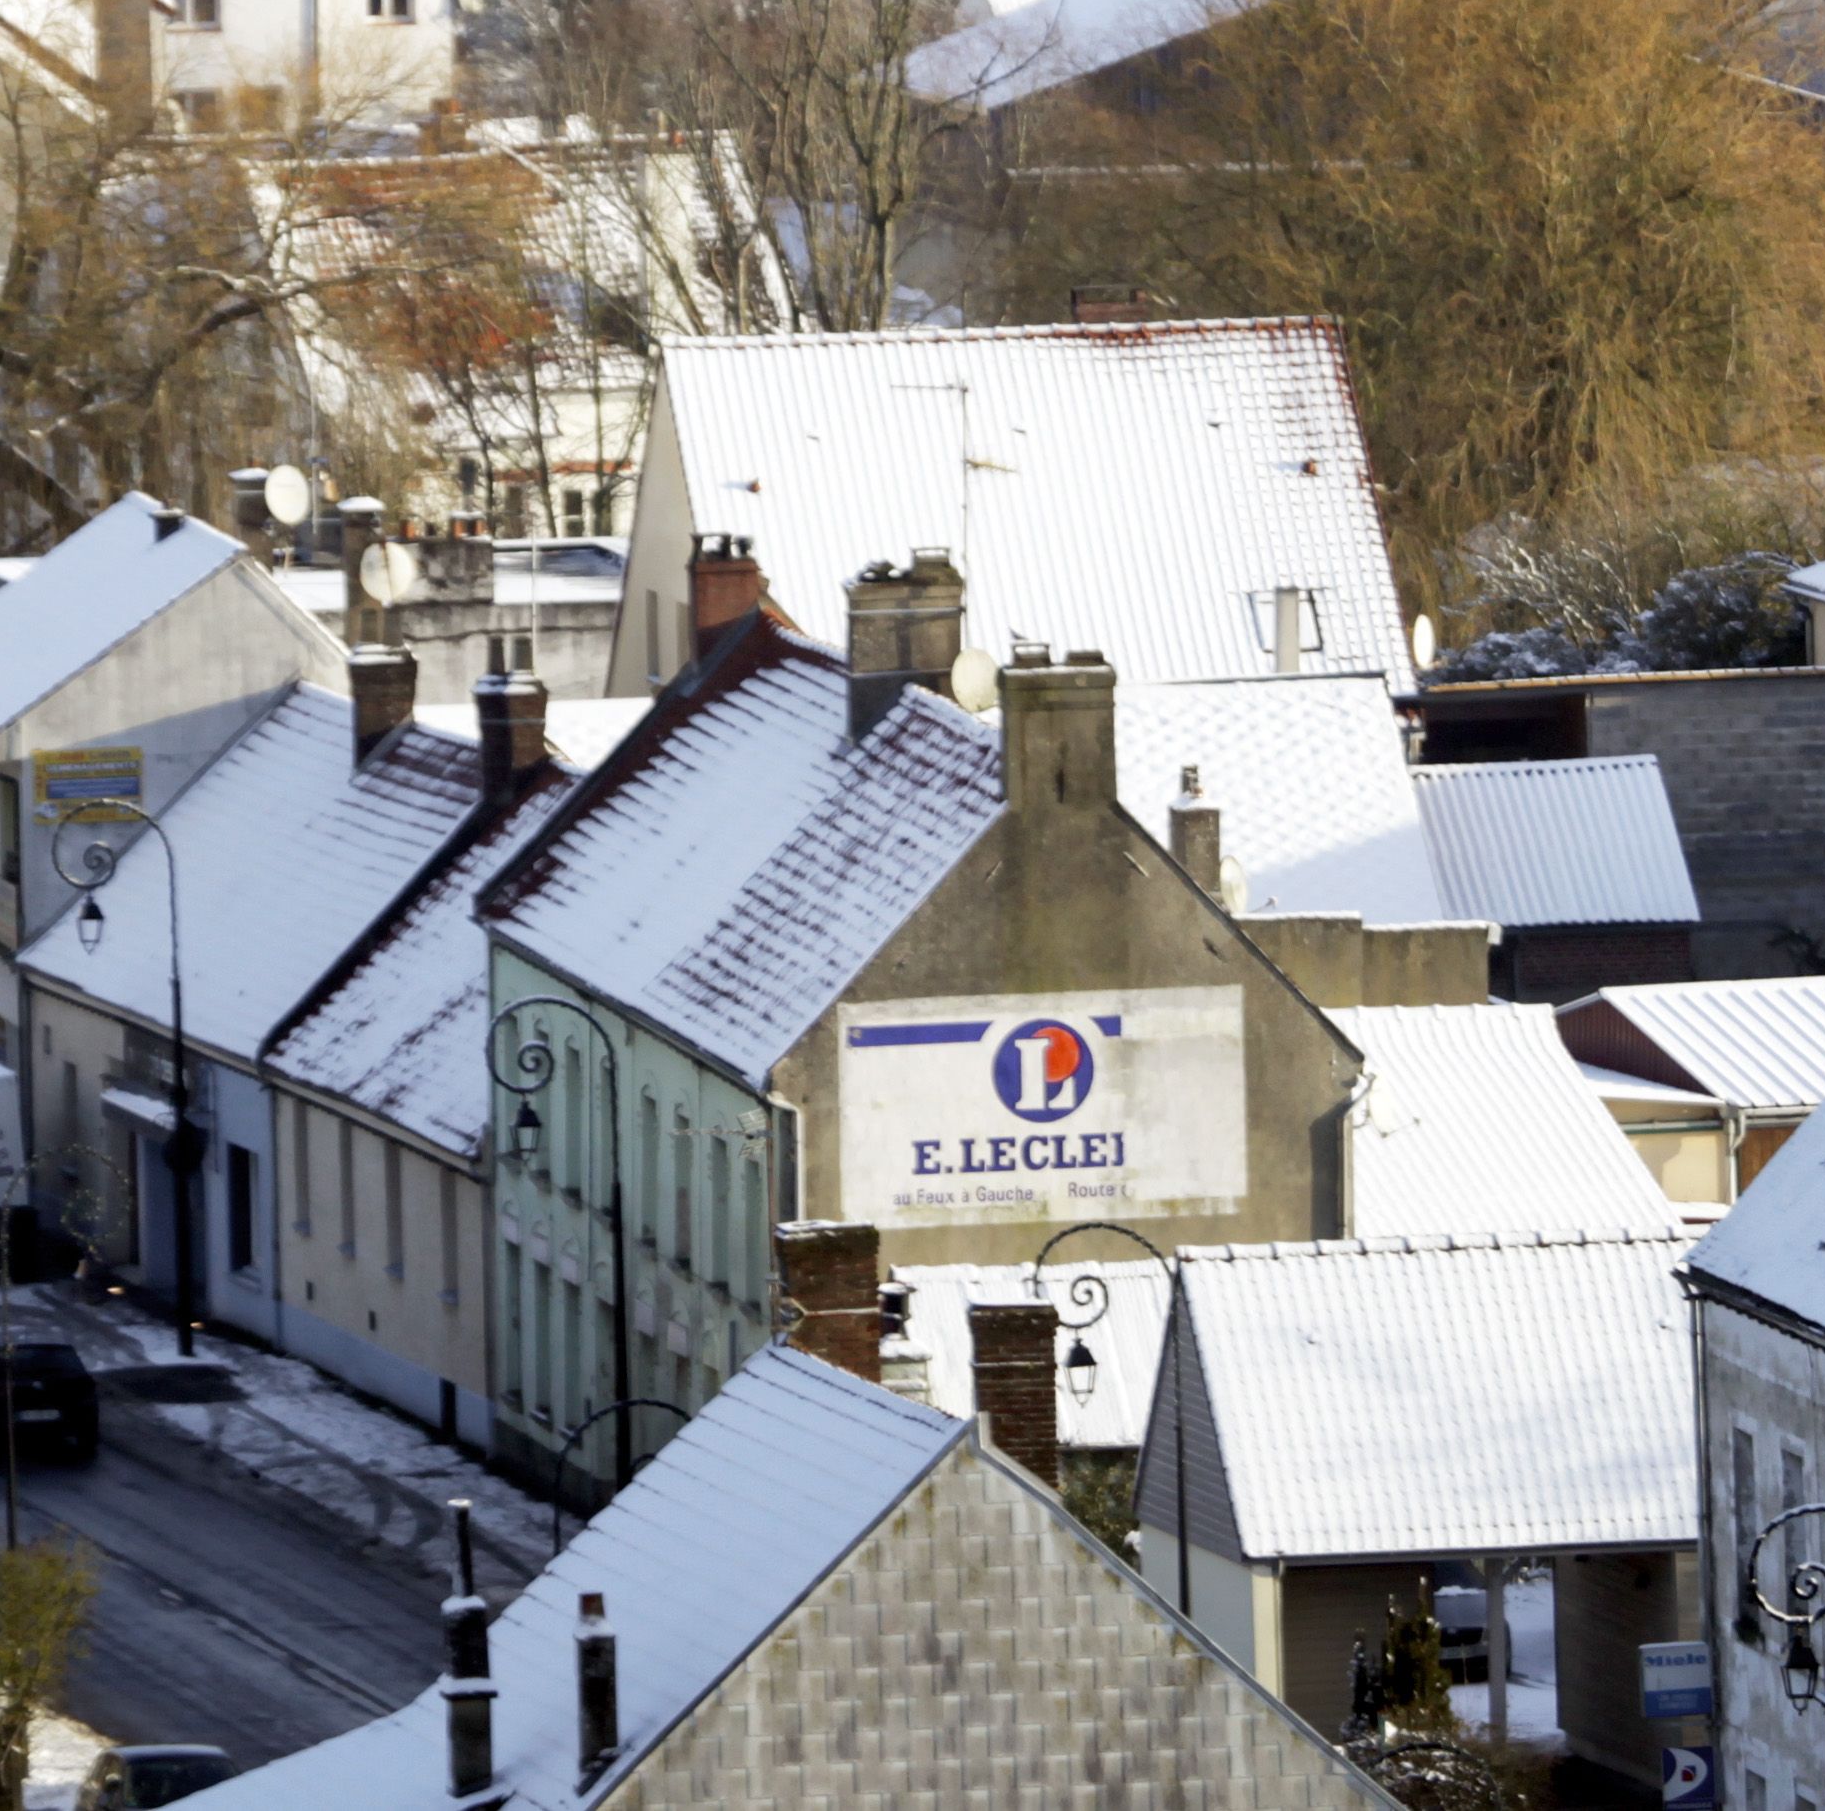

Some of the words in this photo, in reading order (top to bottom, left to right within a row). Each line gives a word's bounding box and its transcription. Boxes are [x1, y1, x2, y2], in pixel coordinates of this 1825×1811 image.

[893, 1193, 912, 1206] au
[916, 1188, 955, 1205] Feux
[961, 1186, 970, 1202] à
[976, 1186, 1034, 1203] Gauche
[1068, 1182, 1116, 1198] Route
